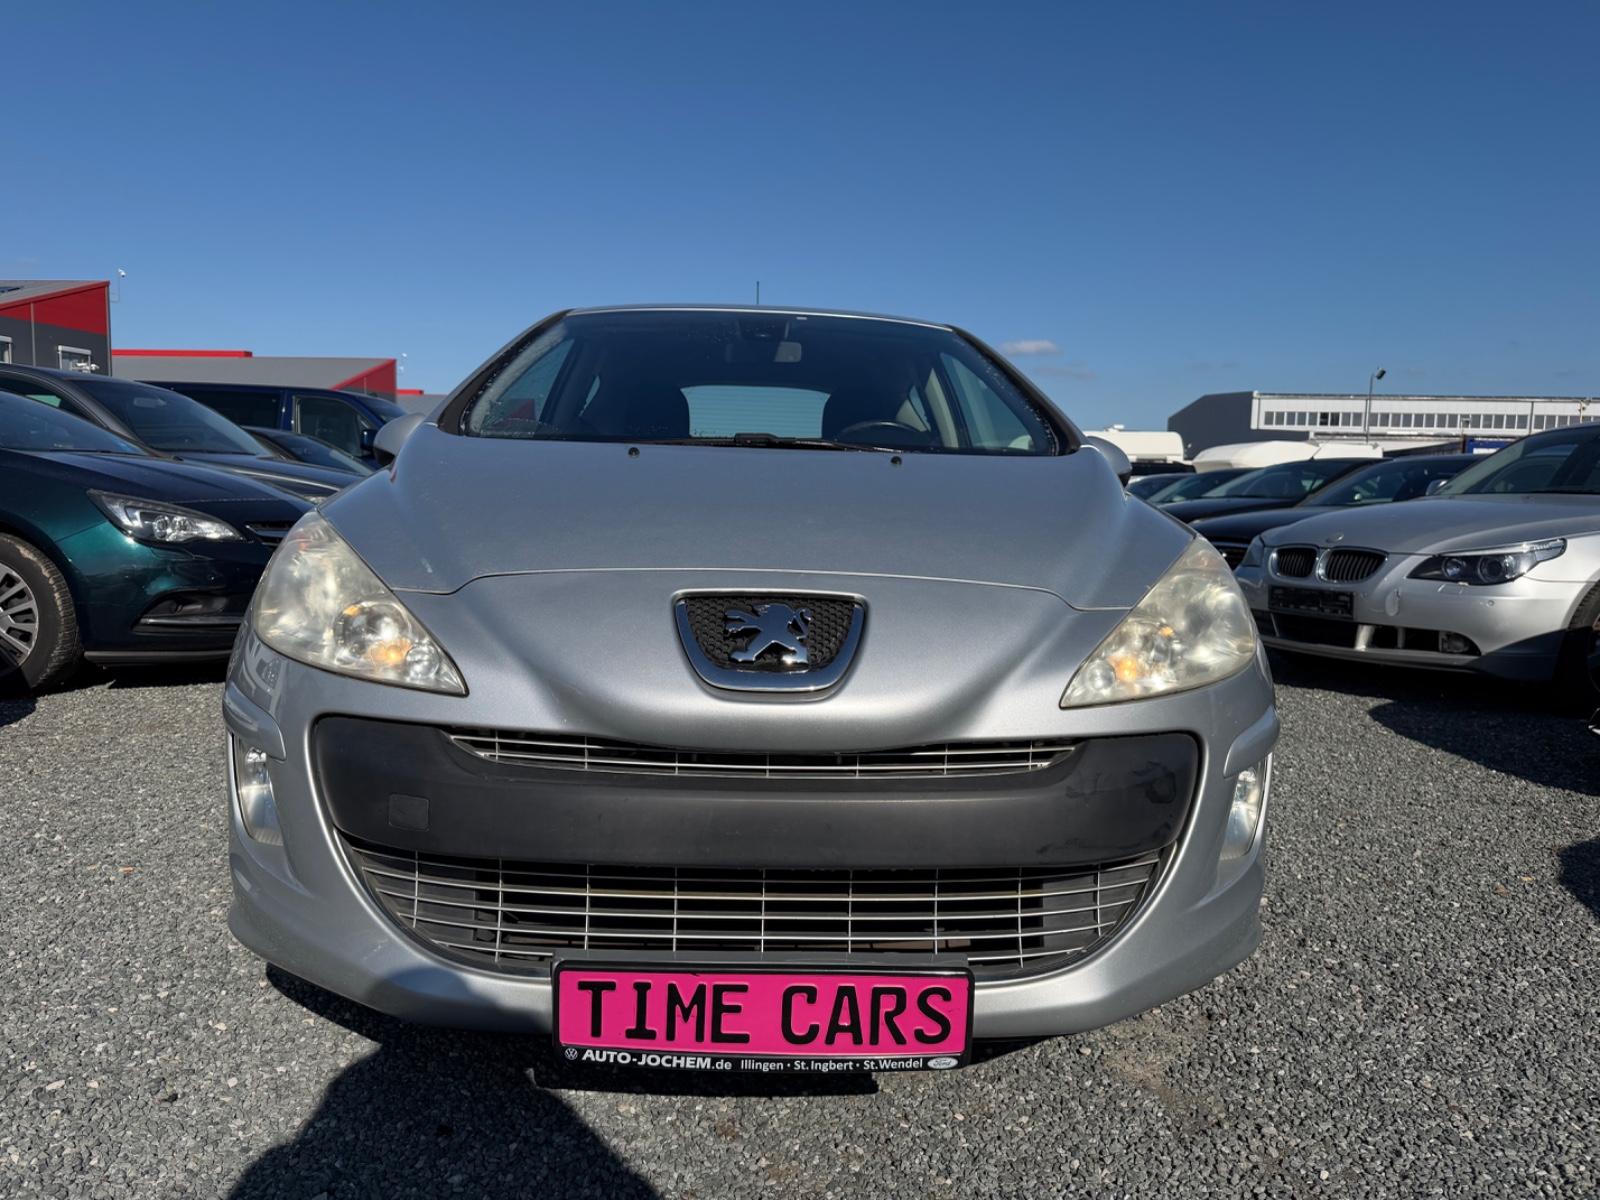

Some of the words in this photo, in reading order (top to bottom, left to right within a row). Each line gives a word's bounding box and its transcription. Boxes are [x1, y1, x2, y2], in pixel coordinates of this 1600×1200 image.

[578, 981, 750, 1043] TIME
[781, 985, 952, 1045] CARS
[741, 1059, 784, 1072] Illingen
